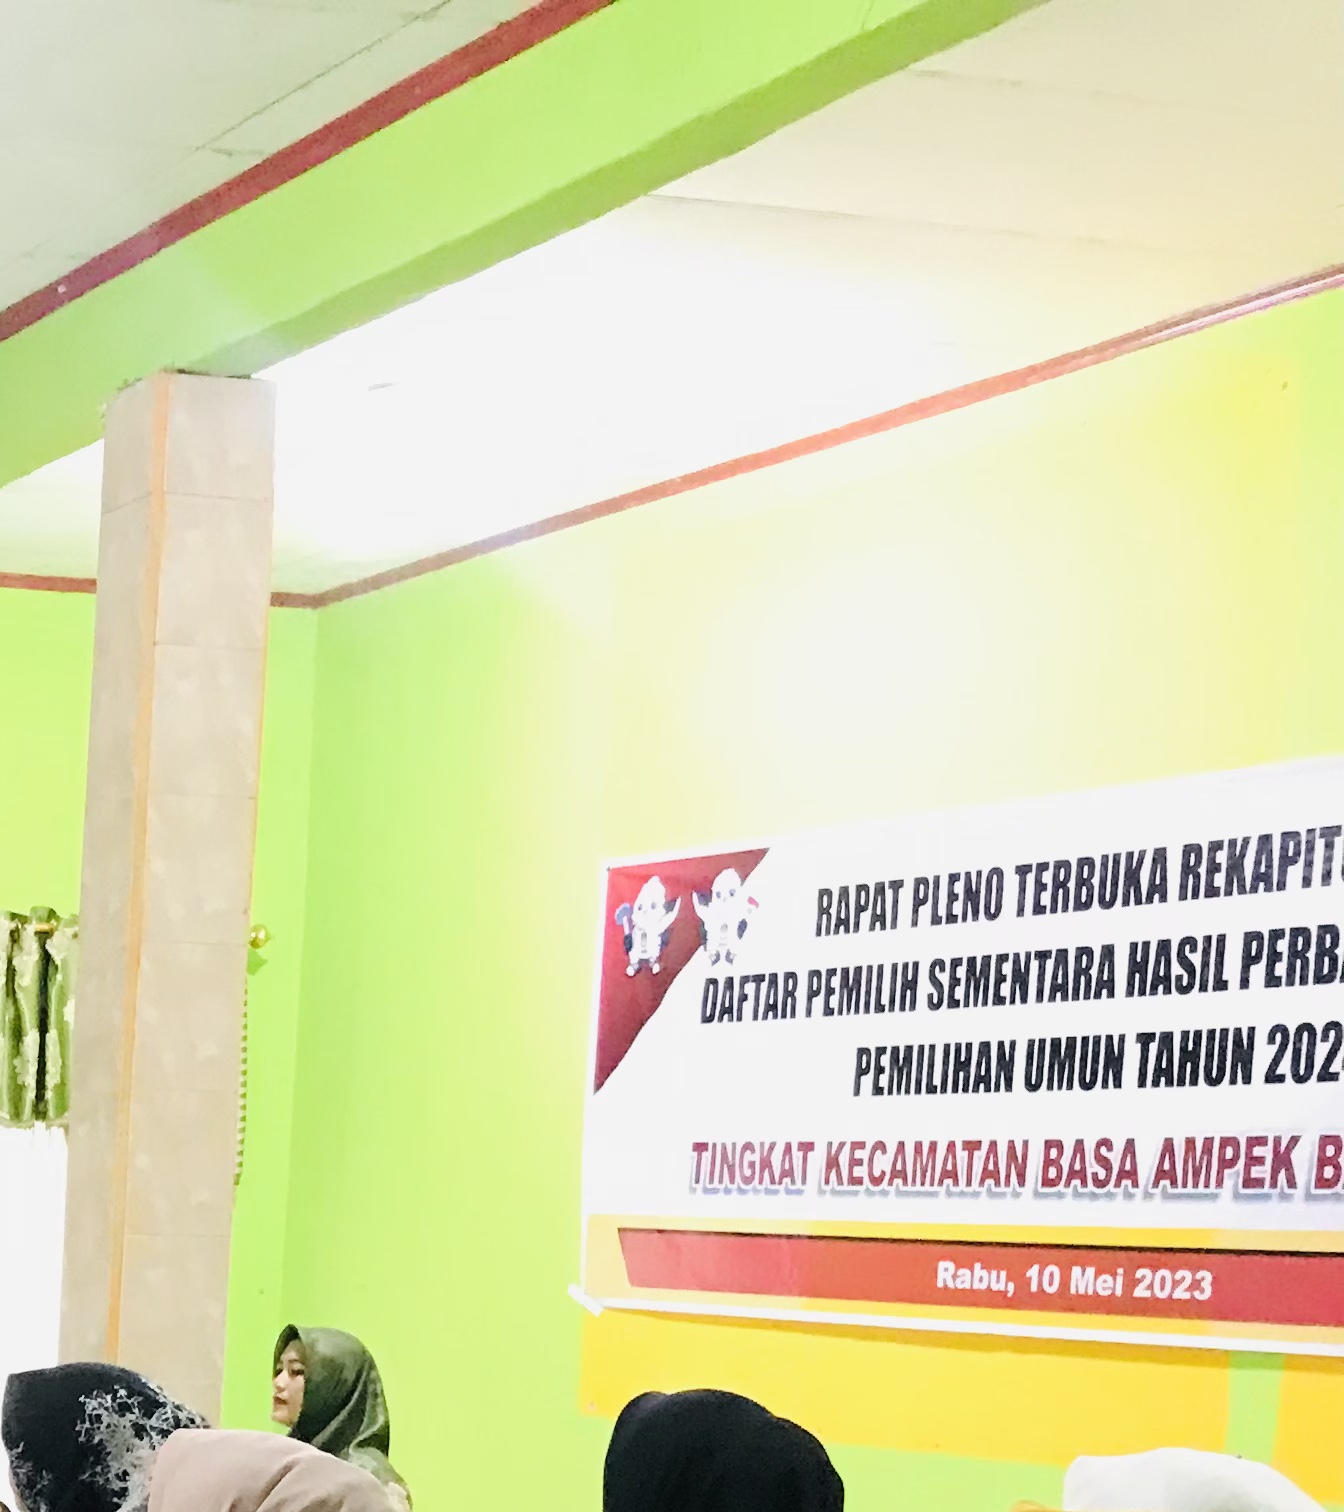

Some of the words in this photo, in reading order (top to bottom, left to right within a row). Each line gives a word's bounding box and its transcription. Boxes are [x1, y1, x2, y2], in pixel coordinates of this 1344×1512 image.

[815, 879, 904, 937] RAPAT
[911, 867, 1004, 928] PLENO
[1015, 847, 1167, 918] TERBUKA
[1178, 825, 1344, 901] REKAPIT
[700, 971, 798, 1024] DAFTAR
[805, 961, 919, 1018] PEMILIH
[927, 944, 1114, 1011] SEMENTARA
[1125, 934, 1229, 997] HASIL
[1239, 924, 1344, 990] PERB
[853, 1039, 1016, 1096] PEMILIHAN
[1024, 1034, 1125, 1093] UMUN
[1136, 1026, 1256, 1088] TAHUN
[1264, 1021, 1344, 1084] 202
[691, 1140, 815, 1188] TINGKAT
[824, 1138, 1029, 1189] KECAMATAN
[1040, 1137, 1140, 1190] BASA
[1151, 1135, 1303, 1190] AMPEK
[1314, 1134, 1344, 1190] B
[936, 1260, 1014, 1298] Rabu,
[1025, 1263, 1060, 1295] 10
[1070, 1265, 1123, 1297] Mei
[1133, 1268, 1212, 1300] 2023
